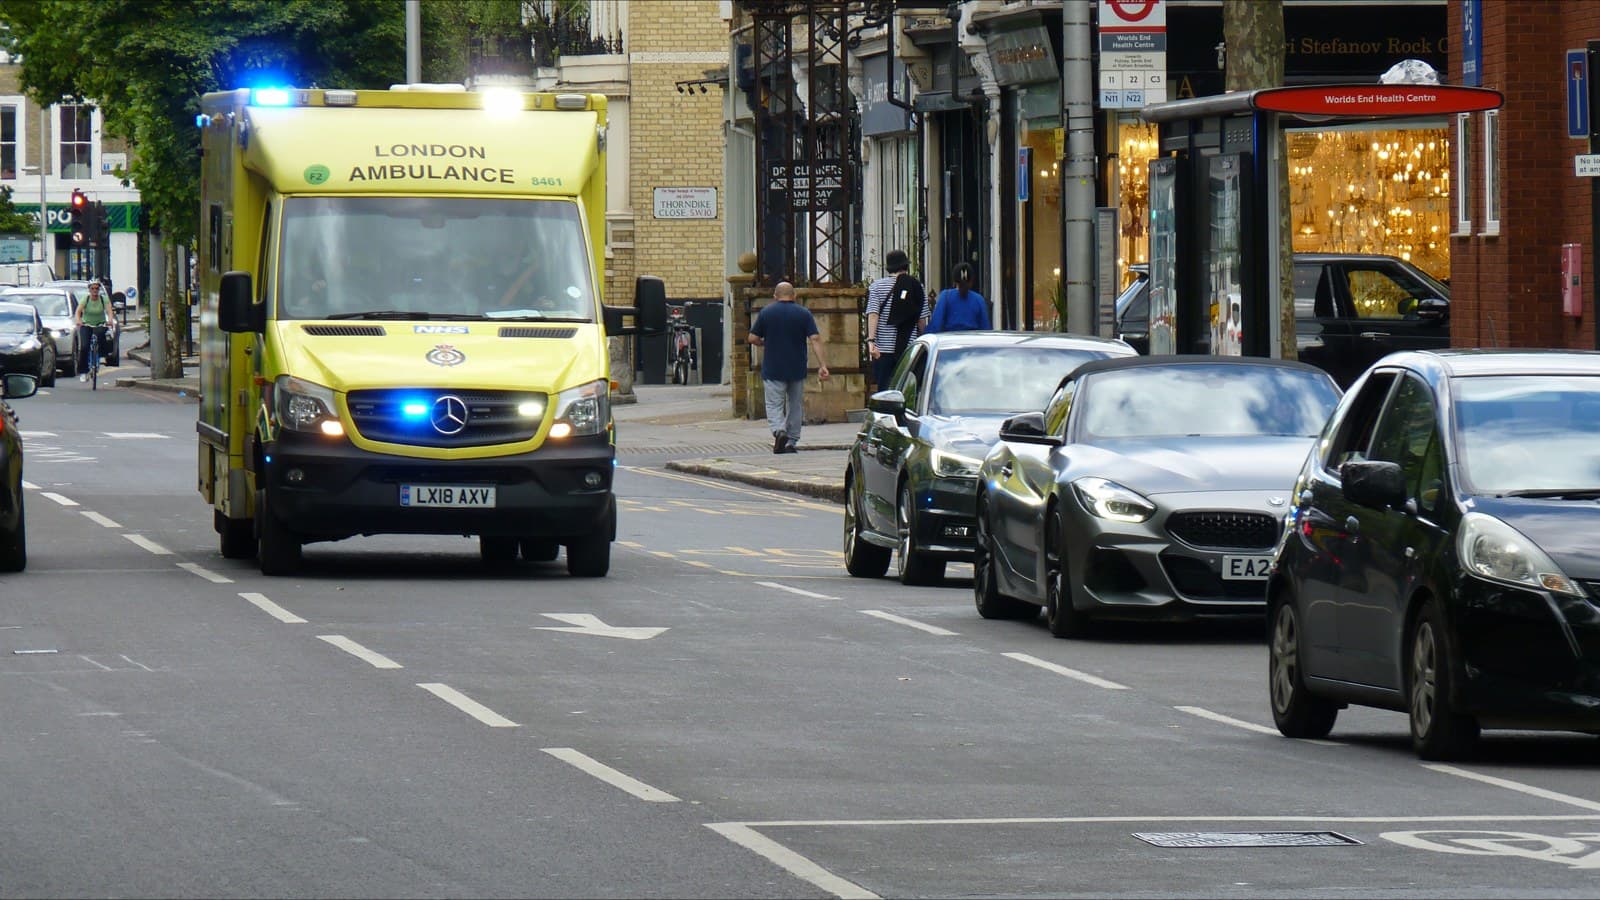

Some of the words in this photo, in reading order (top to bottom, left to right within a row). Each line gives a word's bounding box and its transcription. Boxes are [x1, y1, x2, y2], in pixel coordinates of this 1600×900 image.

[1301, 38, 1382, 54] Stefanov
[1387, 37, 1433, 54] Rock
[1438, 37, 1448, 54] C
[1150, 75, 1161, 83] C3
[1324, 95, 1356, 104] Worlds
[1357, 94, 1373, 103] End
[1376, 94, 1405, 103] Health
[1406, 94, 1437, 102] Centre
[374, 144, 486, 159] LONDON
[309, 172, 323, 181] F2
[349, 165, 516, 184] AMBULANCE
[531, 176, 563, 186] 8461
[659, 200, 713, 209] THORNDIKE
[416, 325, 467, 335] NHS
[416, 487, 454, 504] LX18
[458, 488, 489, 504] AXV
[1231, 558, 1270, 577] EA2
